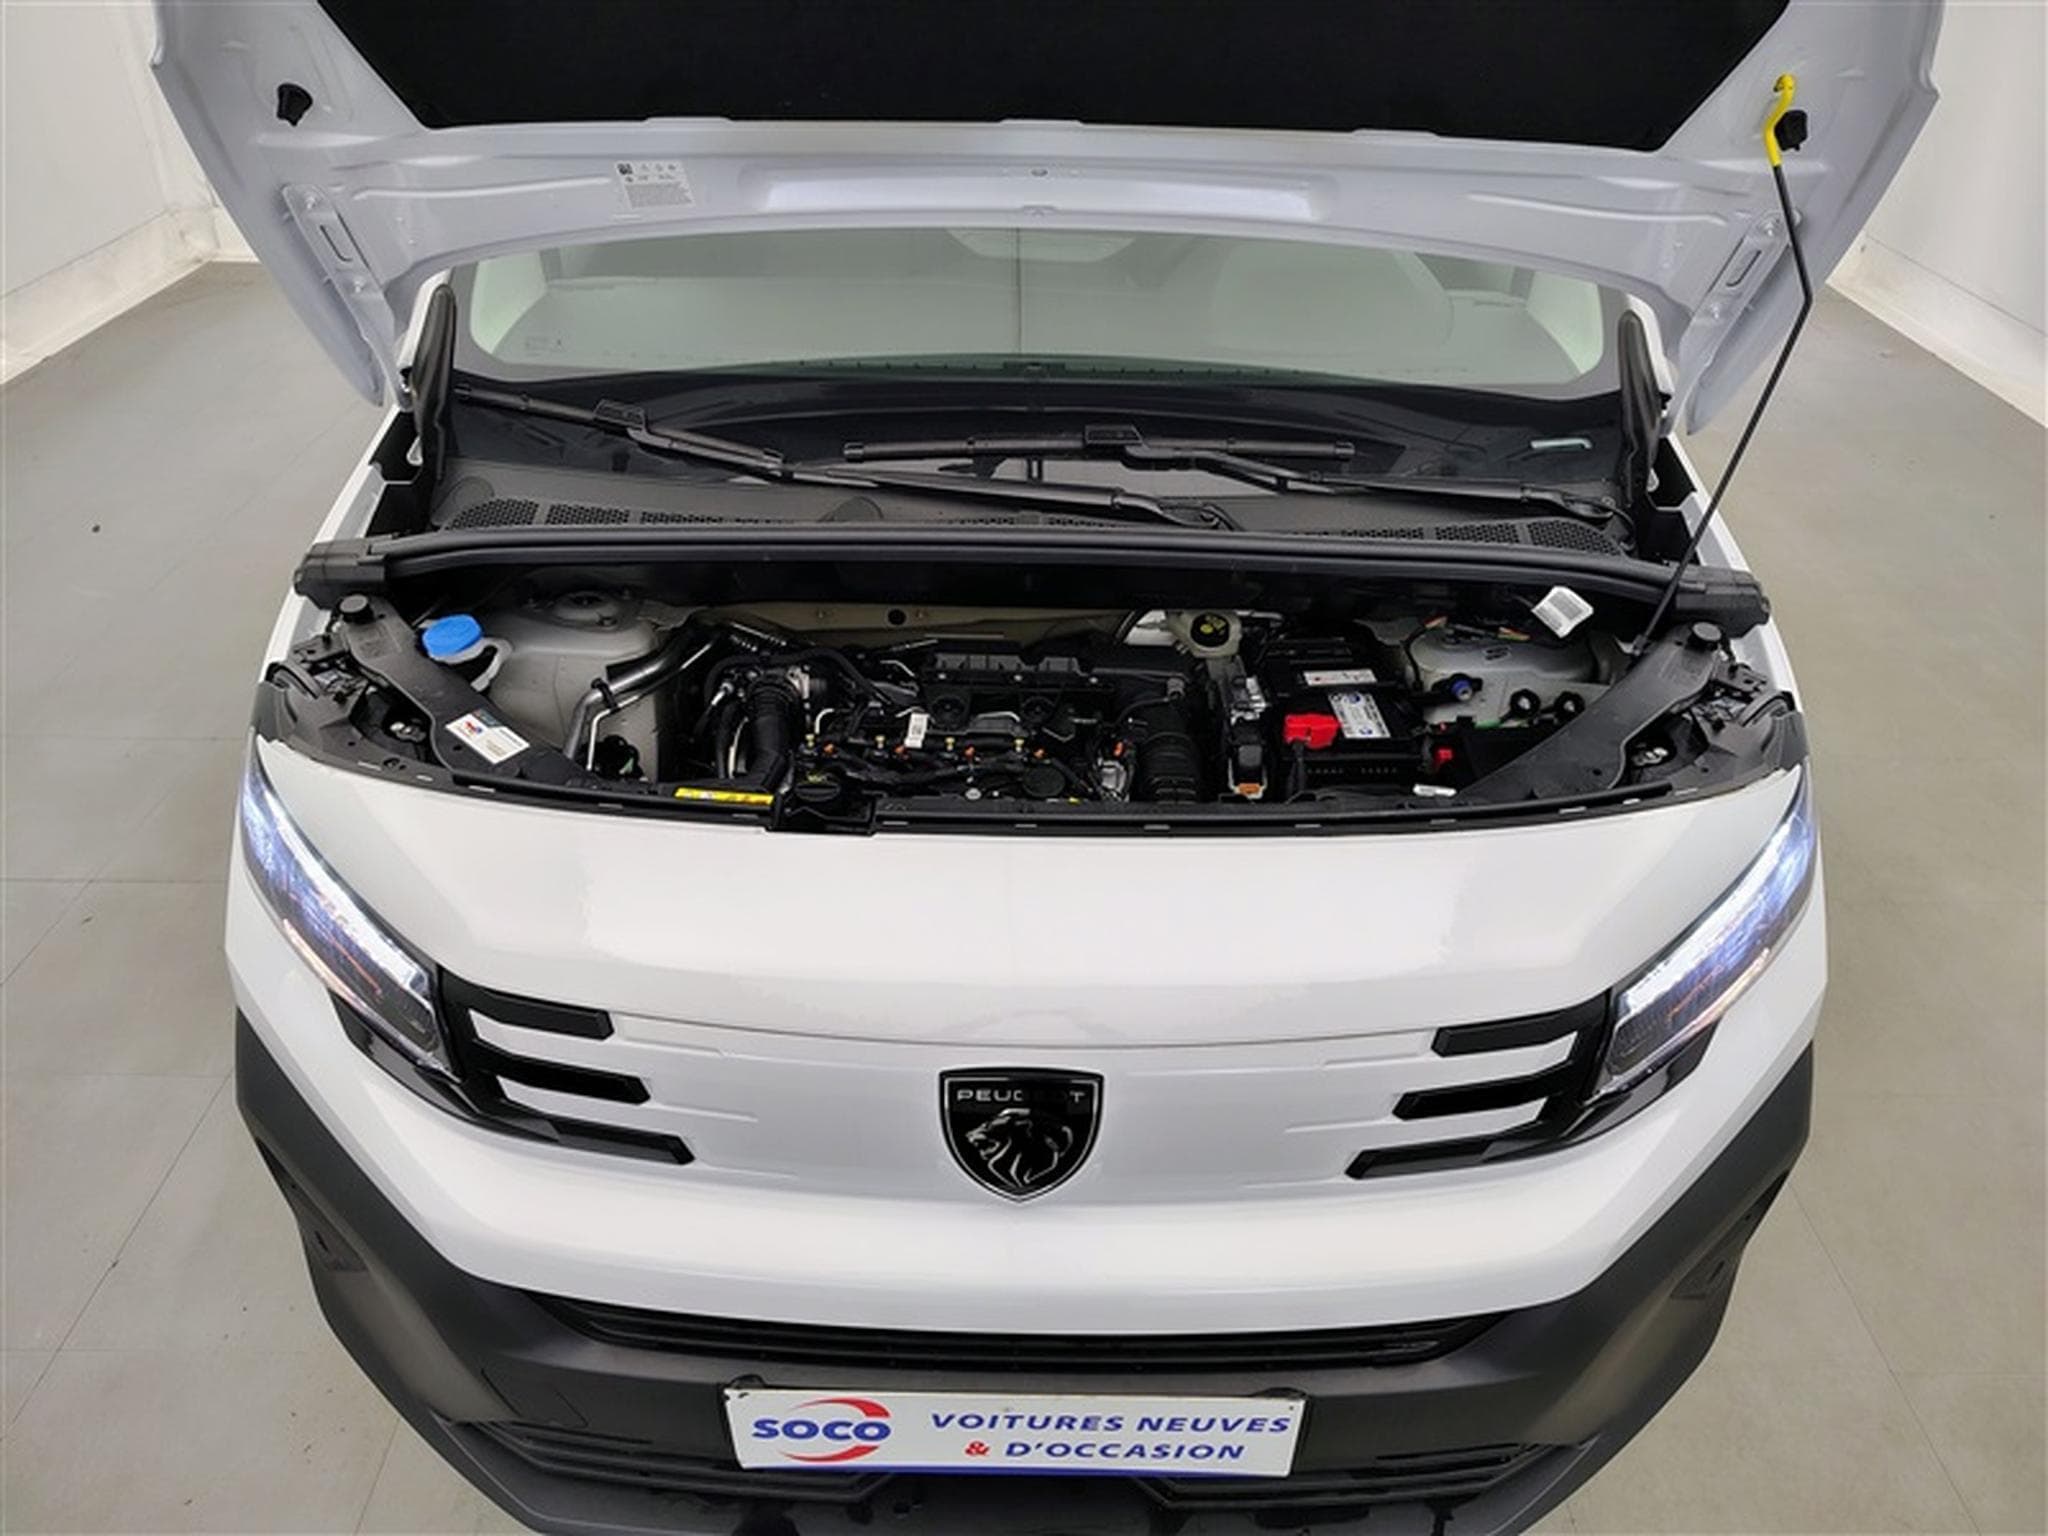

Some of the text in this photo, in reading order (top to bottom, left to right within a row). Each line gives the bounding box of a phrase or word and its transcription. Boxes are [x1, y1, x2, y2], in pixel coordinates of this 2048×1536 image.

[956, 1089, 1086, 1103] PEUT
[752, 1418, 891, 1442] SOCO
[932, 1413, 1291, 1433] VOITURES NEUVES
[965, 1441, 1245, 1460] & D'OCCASION
